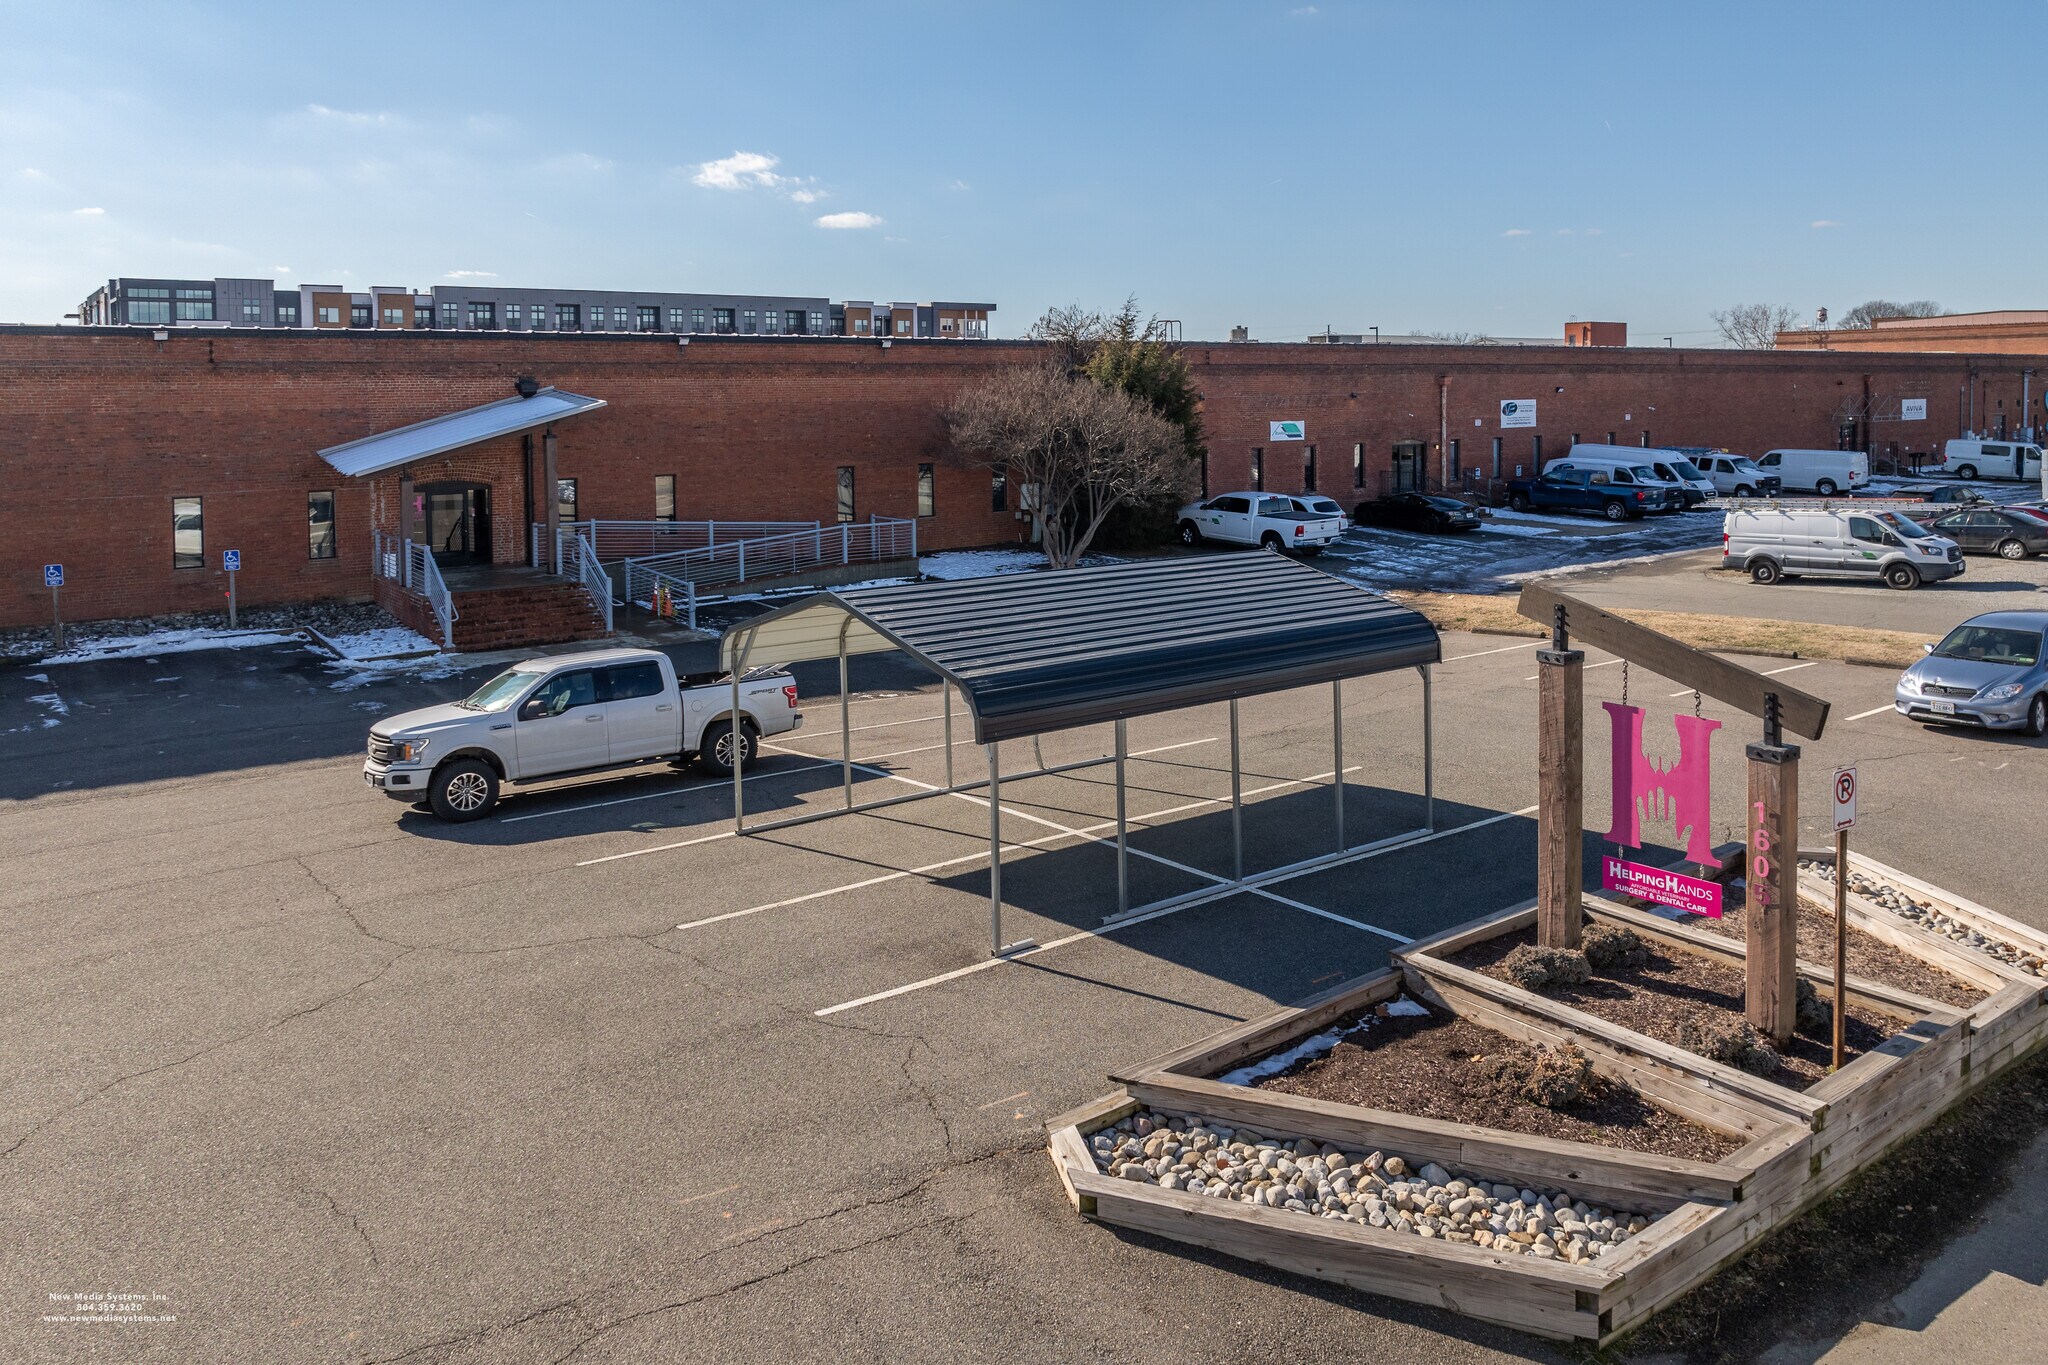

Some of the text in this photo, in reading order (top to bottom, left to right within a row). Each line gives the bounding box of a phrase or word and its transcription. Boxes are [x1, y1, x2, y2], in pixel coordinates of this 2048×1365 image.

[1753, 801, 1771, 906] 1605
[1615, 883, 1647, 898] SURGERY
[1656, 894, 1685, 908] DENTAL
[1686, 902, 1707, 914] CARE
[1630, 883, 1690, 902] AFFORDABLE VETERINARY
